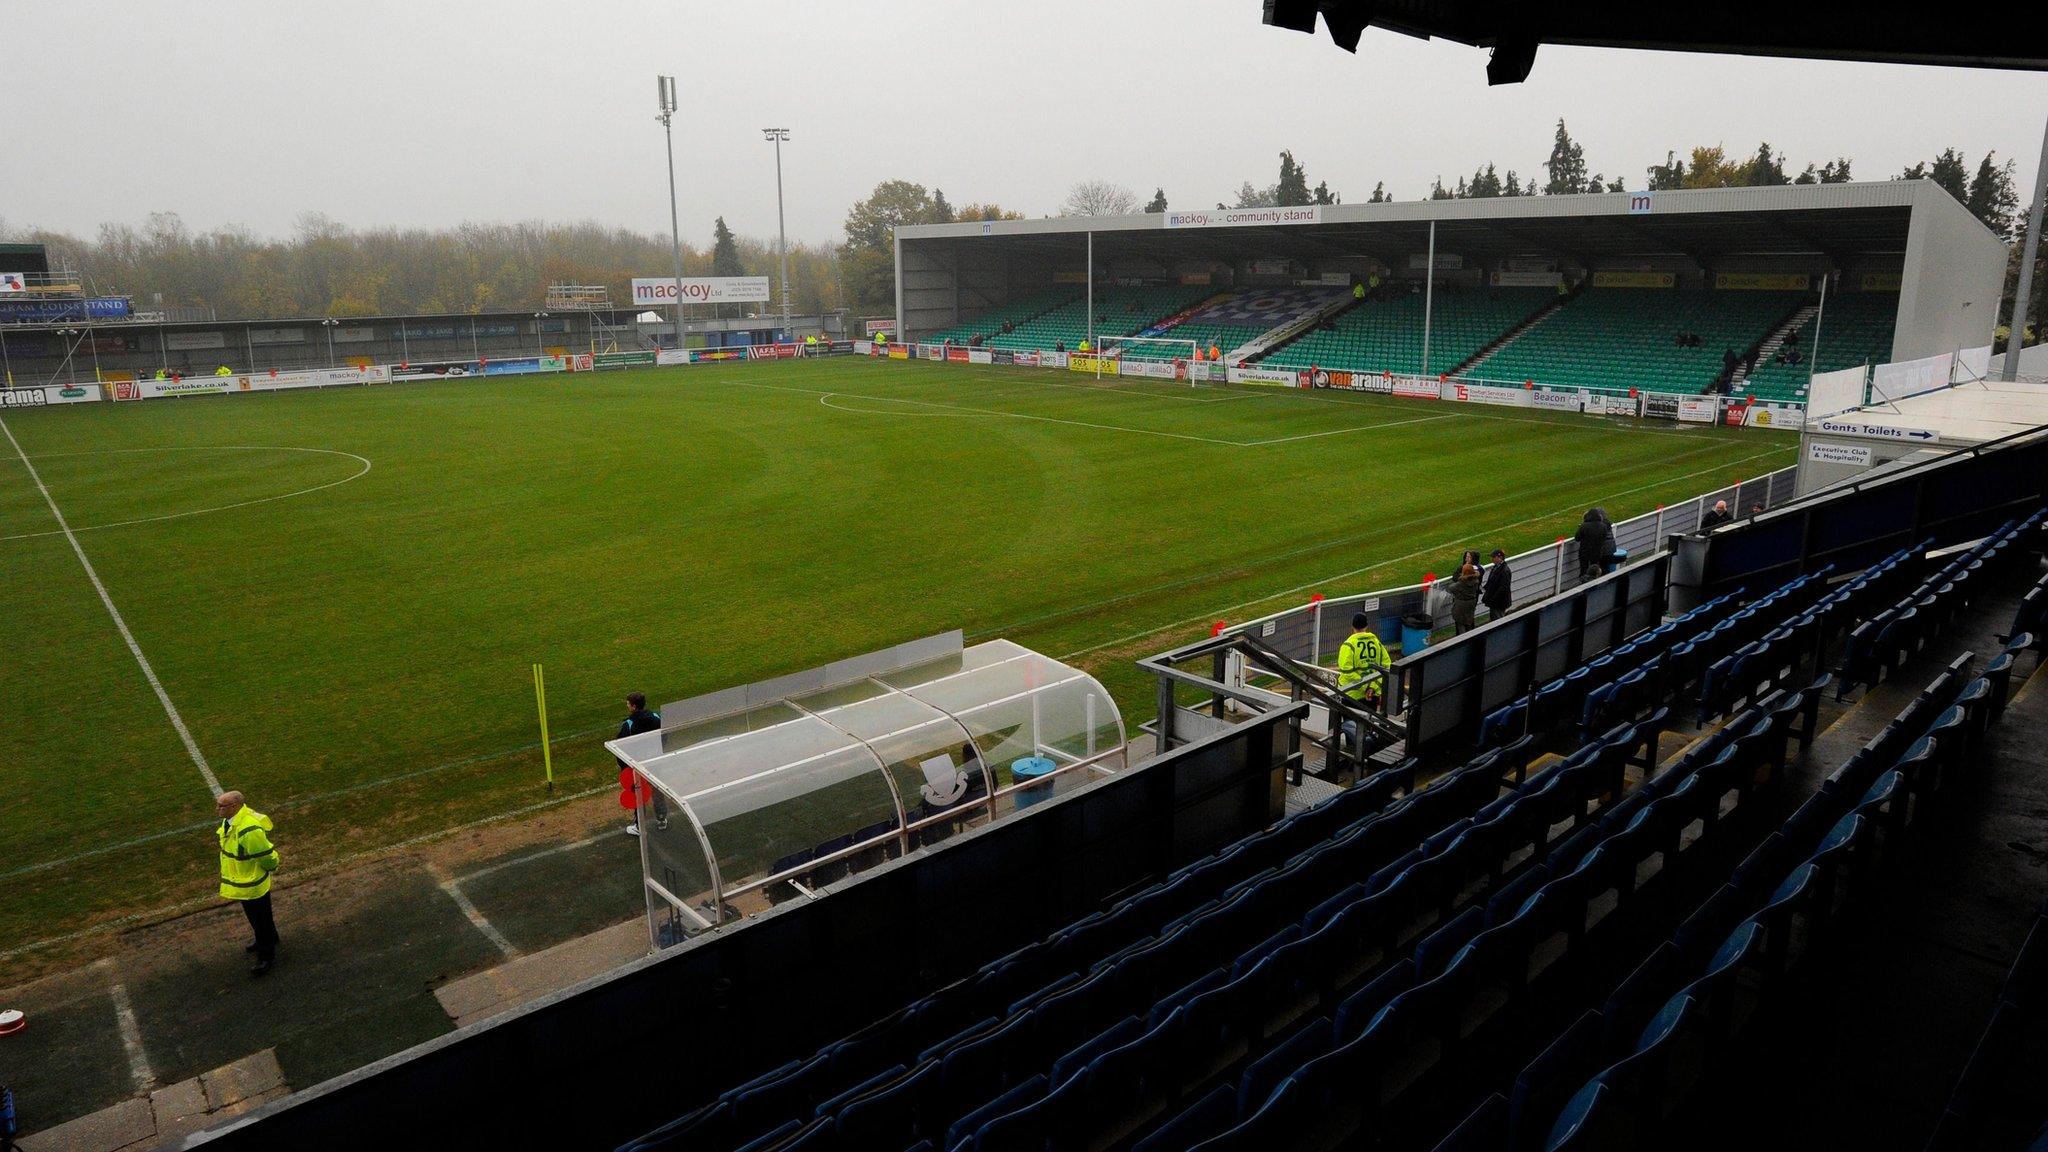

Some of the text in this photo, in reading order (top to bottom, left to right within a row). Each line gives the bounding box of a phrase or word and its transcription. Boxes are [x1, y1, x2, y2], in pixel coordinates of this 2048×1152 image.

[1632, 196, 1650, 210] m
[1170, 214, 1208, 226] mackoy
[1226, 210, 1280, 223] community
[1284, 209, 1314, 220] stand
[637, 284, 710, 300] mackoy
[84, 301, 122, 310] STAND
[1073, 358, 1087, 366] SOS
[1238, 373, 1290, 381] Silverlake.co.uk
[1330, 372, 1392, 389] vanarama
[155, 382, 229, 391] Silverlake.co.uk
[1534, 392, 1566, 402] Beacon
[1823, 422, 1902, 436] Gents Toilets
[1824, 453, 1864, 462] Hospitality
[1357, 641, 1376, 659] 26
